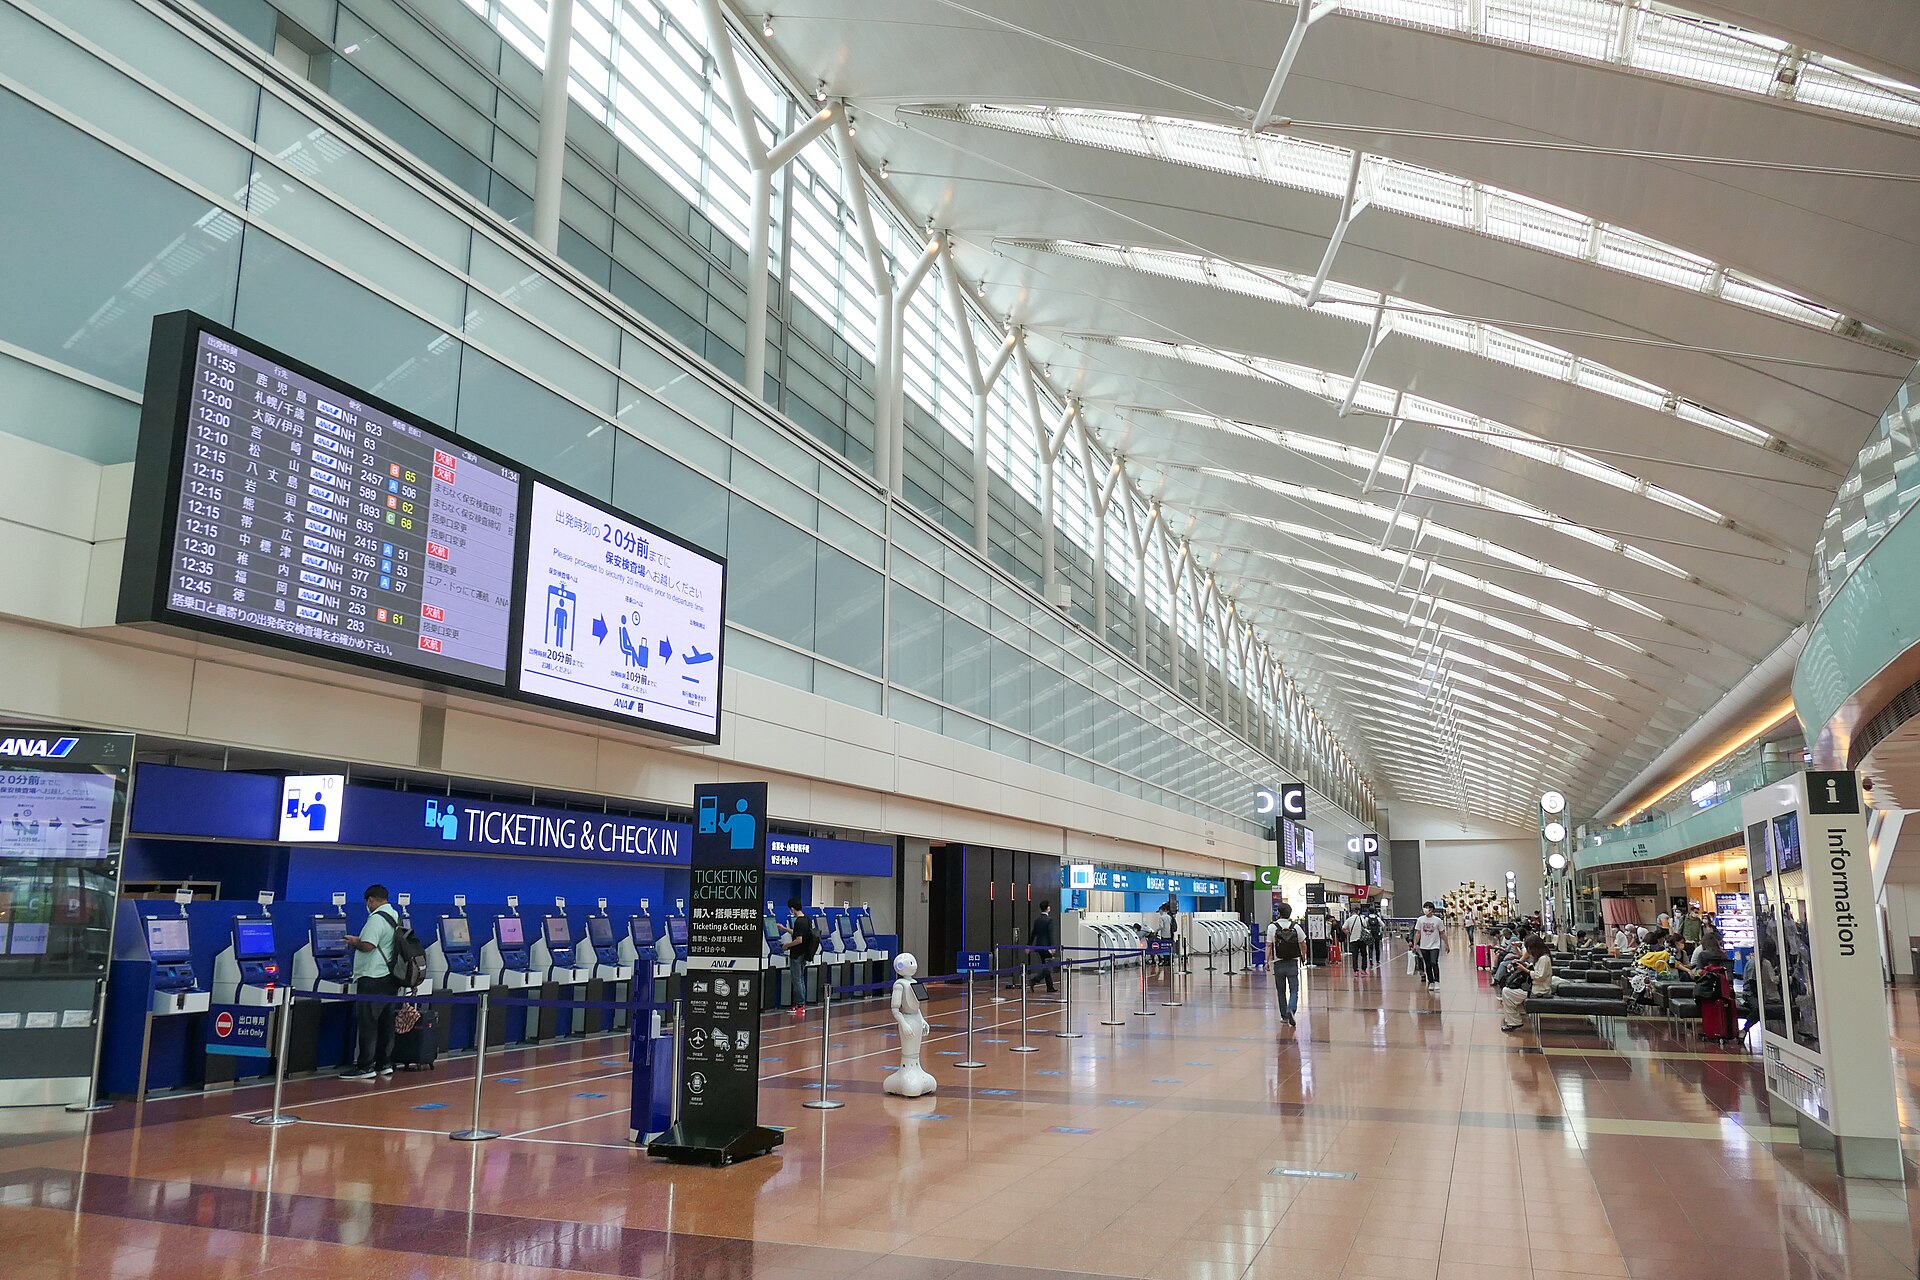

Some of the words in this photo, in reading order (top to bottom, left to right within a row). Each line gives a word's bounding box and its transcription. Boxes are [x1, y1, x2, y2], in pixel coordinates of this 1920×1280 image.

[204, 370, 234, 392] 12:00
[254, 390, 306, 422] 札幌/千歳
[340, 428, 356, 442] NH
[364, 438, 376, 450] 63
[206, 352, 236, 374] 11:55
[342, 411, 358, 426] NH
[366, 422, 382, 436] 623
[200, 407, 230, 428] 12:00
[338, 460, 352, 475] NH
[360, 470, 384, 486] 2457
[402, 485, 416, 499] 506
[202, 388, 232, 410] 12:00
[252, 408, 304, 438] 大阪/伊丹
[339, 444, 354, 458] NH
[362, 454, 374, 466] 23
[404, 471, 416, 482] 65
[195, 444, 226, 464] 12:15
[334, 494, 350, 508] NH
[358, 502, 380, 518] 1893
[401, 518, 412, 530] 68
[431, 528, 466, 550] 搭乗口変更
[198, 426, 228, 446] 12:10
[336, 477, 351, 492] NH
[359, 486, 376, 500] 589
[402, 502, 414, 514] 62
[432, 514, 468, 534] 搭乗口変更
[501, 468, 518, 482] 11:34
[190, 481, 222, 500] 12:15
[331, 526, 346, 541] NH
[354, 535, 378, 552] 2415
[398, 549, 408, 561] 51
[193, 462, 224, 482] 12:15
[332, 510, 348, 524] NH
[356, 519, 374, 533] 635
[431, 545, 446, 558] 欠航
[186, 518, 218, 538] 12:15
[328, 561, 342, 575] NH
[352, 568, 370, 582] 377
[395, 581, 406, 592] 57
[188, 500, 220, 519] 12:15
[329, 544, 344, 558] NH
[352, 552, 376, 568] 4765
[396, 566, 408, 578] 53
[184, 538, 216, 556] 12:30
[326, 578, 341, 592] NH
[350, 585, 368, 599] 573
[426, 606, 442, 620] 欠航
[553, 548, 572, 562] Please
[575, 558, 598, 572] proceed
[605, 569, 625, 584] security
[606, 551, 702, 598] 保安検査場へお越しください
[180, 576, 212, 594] 12:45
[322, 612, 338, 626] NH
[346, 618, 364, 632] 283
[424, 637, 438, 650] 欠航
[182, 556, 214, 575] 12:35
[324, 595, 340, 608] NH
[348, 602, 366, 616] 253
[392, 614, 403, 625] 61
[0, 738, 48, 757] ANA
[322, 778, 334, 789] 10
[1284, 790, 1302, 813] C
[1549, 796, 1558, 809] 5
[464, 808, 576, 849] TICKETING
[580, 820, 594, 851] &
[598, 822, 658, 855] CHECK
[662, 829, 678, 856] IN
[1364, 838, 1378, 852] D
[694, 870, 758, 884] TICKETING
[744, 886, 757, 899] IN
[1261, 872, 1271, 884] C
[1828, 828, 1857, 956] Information
[693, 908, 758, 918] 購入・搭乗手続き
[693, 922, 722, 932] Ticketing
[711, 960, 728, 968] ANA
[238, 1016, 266, 1026] 出口専用
[250, 1029, 264, 1037] Only
